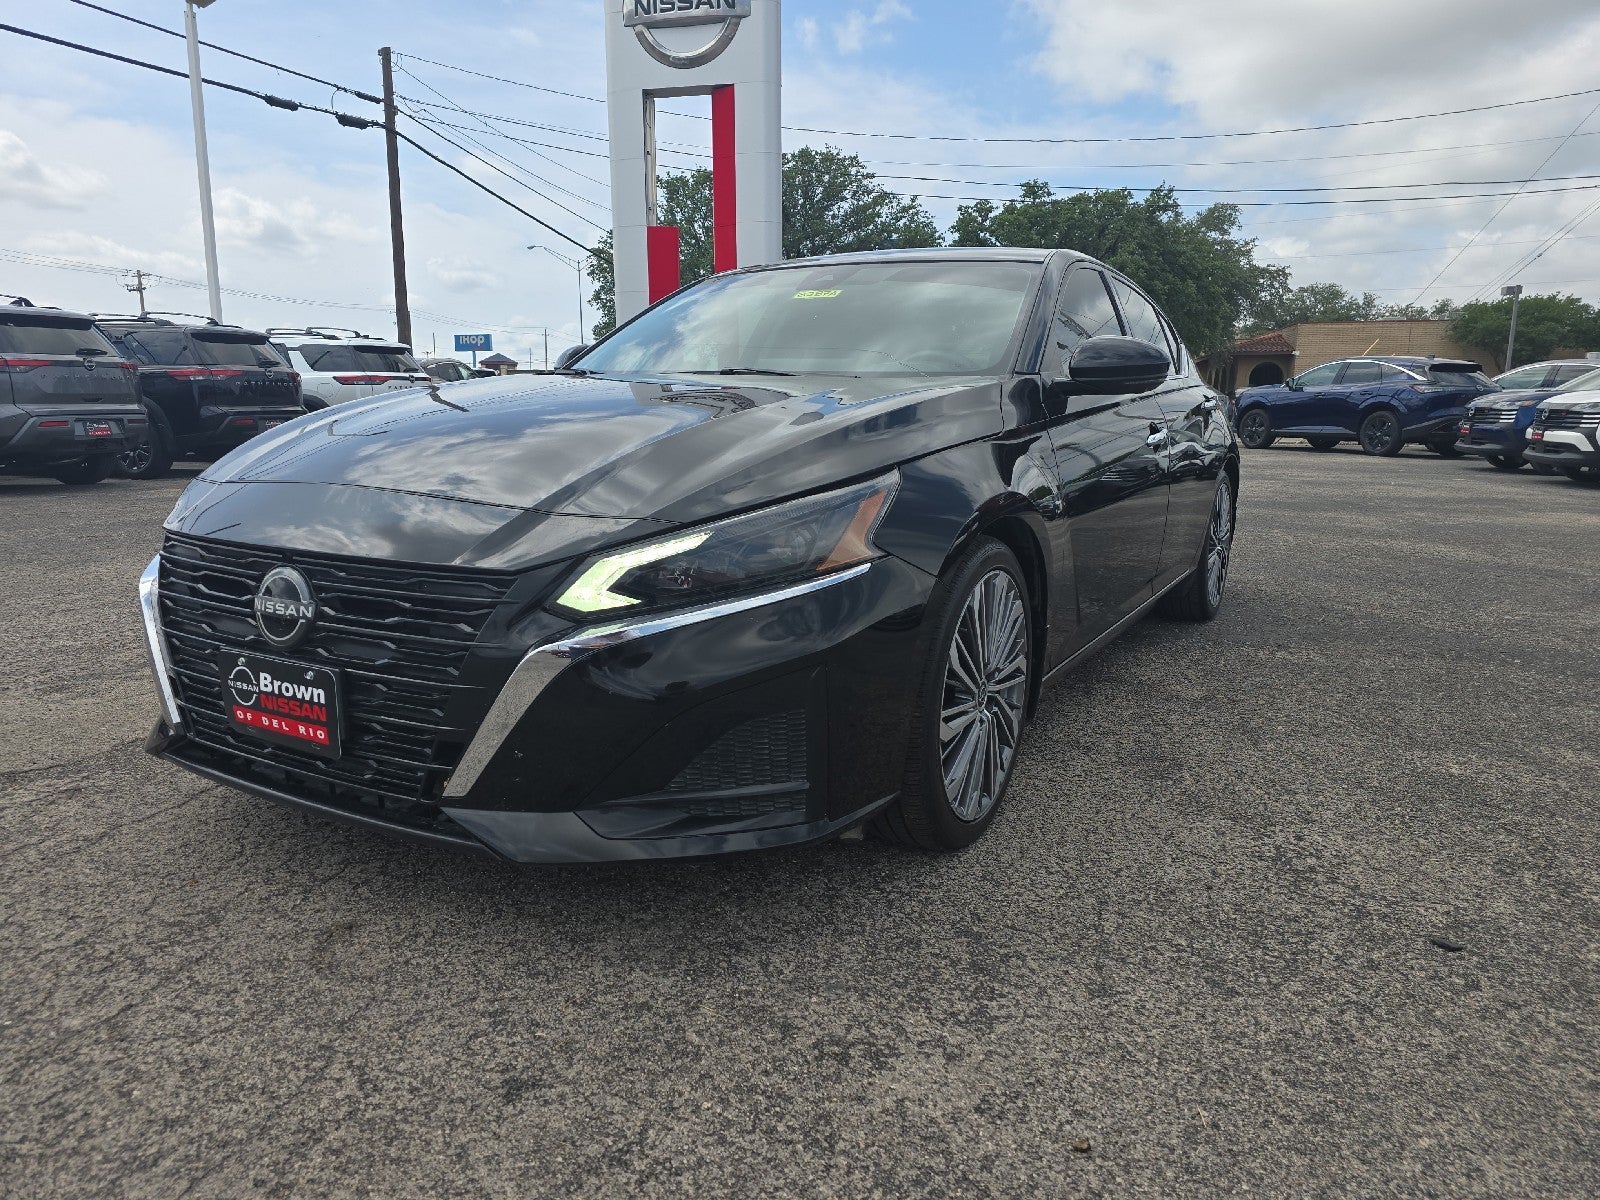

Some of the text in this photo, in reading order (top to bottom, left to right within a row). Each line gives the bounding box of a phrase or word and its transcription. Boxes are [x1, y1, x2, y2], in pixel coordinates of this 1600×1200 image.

[254, 597, 312, 618] NISSAN
[227, 679, 259, 693] NISSAN
[259, 671, 326, 705] Brown
[260, 693, 327, 722] NISSAN
[236, 710, 325, 739] OF DEL RIO
